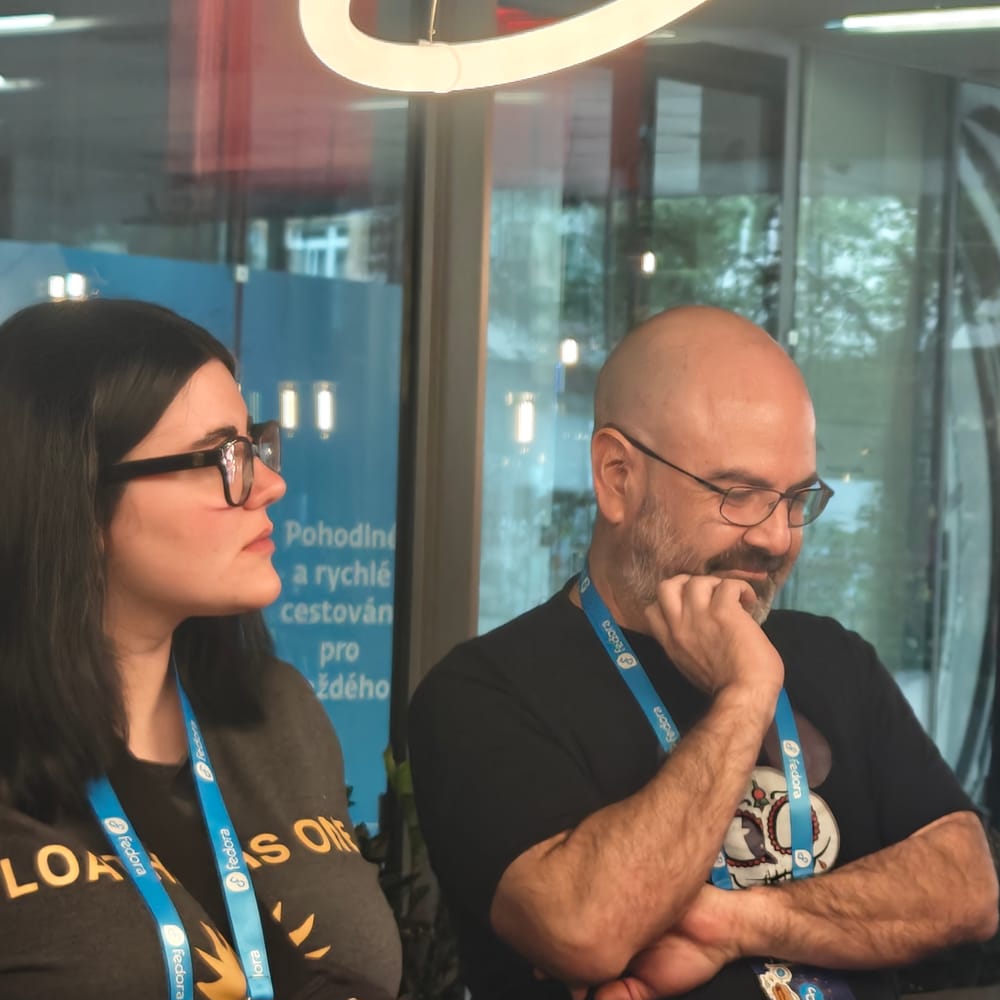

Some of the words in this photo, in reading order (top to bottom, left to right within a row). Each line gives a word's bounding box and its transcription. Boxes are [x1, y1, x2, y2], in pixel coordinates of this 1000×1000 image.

[293, 564, 308, 586] a
[315, 560, 391, 591] rychlé
[320, 640, 360, 666] pro
[602, 619, 627, 653] fedora
[307, 672, 390, 701] ždého
[788, 758, 802, 800] fedora
[119, 833, 146, 877] fedora
[219, 828, 241, 870] fedora
[171, 948, 185, 1000] fedora
